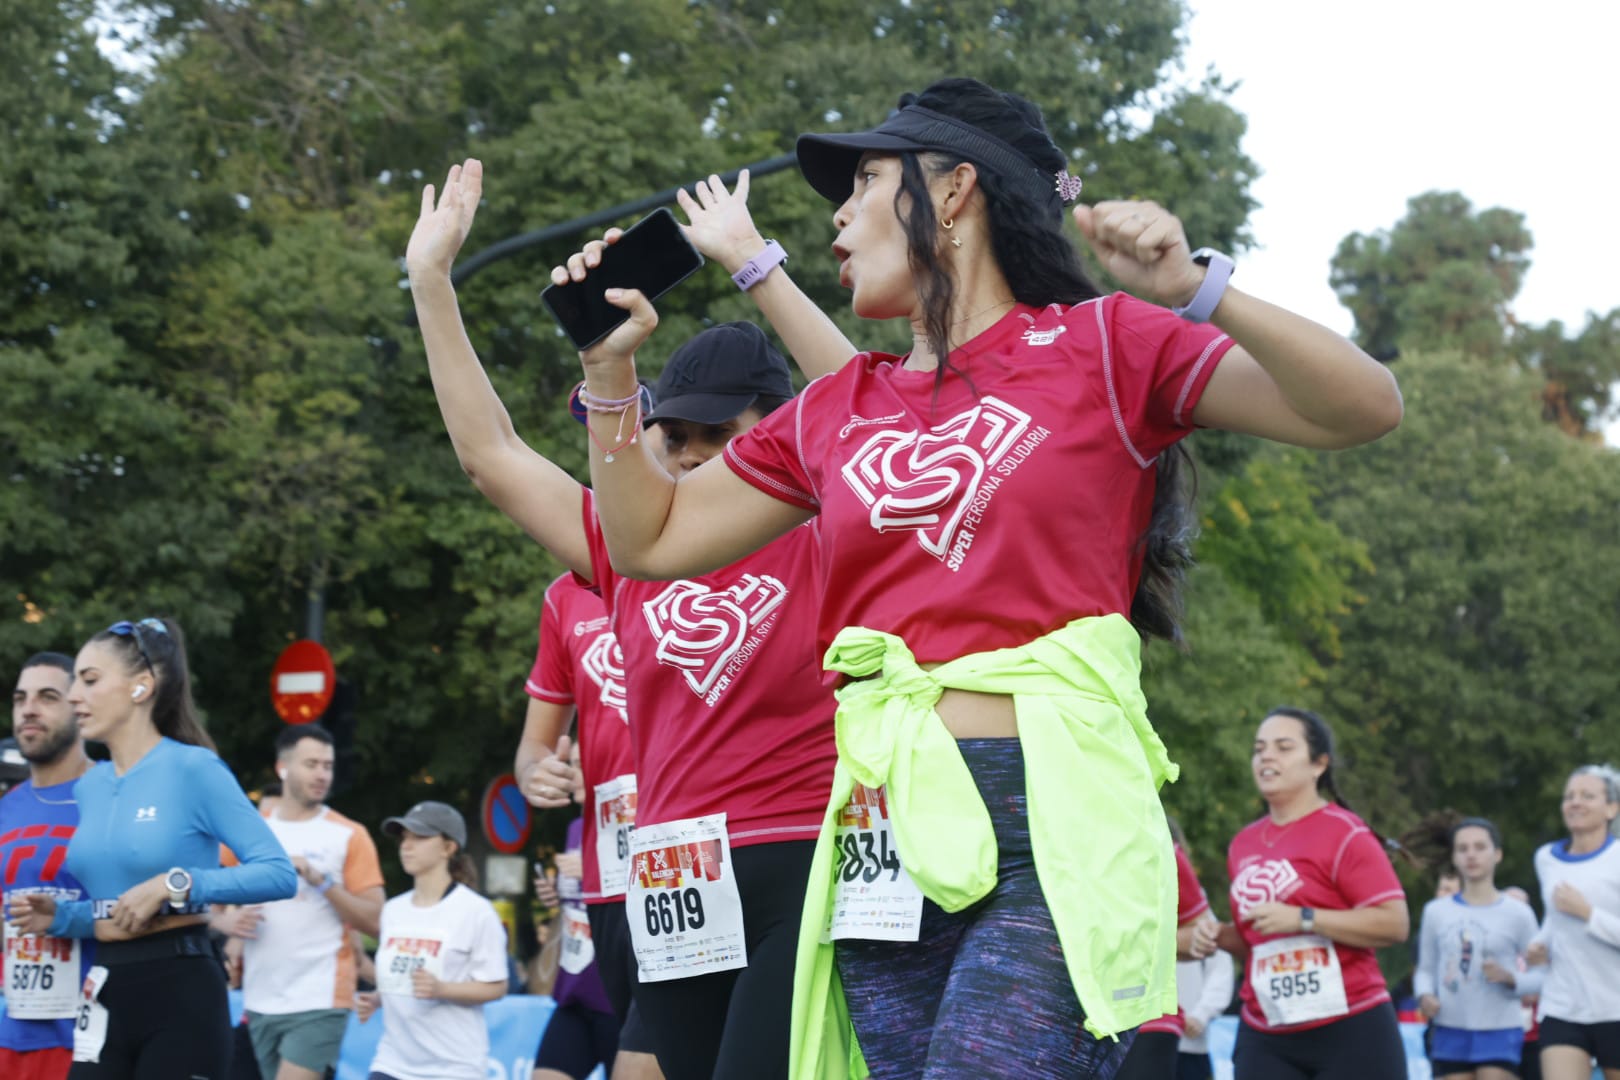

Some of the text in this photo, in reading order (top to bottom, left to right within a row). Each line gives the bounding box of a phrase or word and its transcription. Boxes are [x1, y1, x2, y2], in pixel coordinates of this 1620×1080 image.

[947, 425, 1052, 572] SÚPER PERSONA SOLIDARIA
[705, 674, 731, 707] SÚPER
[726, 635, 762, 677] PERSONA
[644, 887, 705, 936] 6619
[12, 964, 55, 990] 5876
[1270, 971, 1321, 1000] 5955
